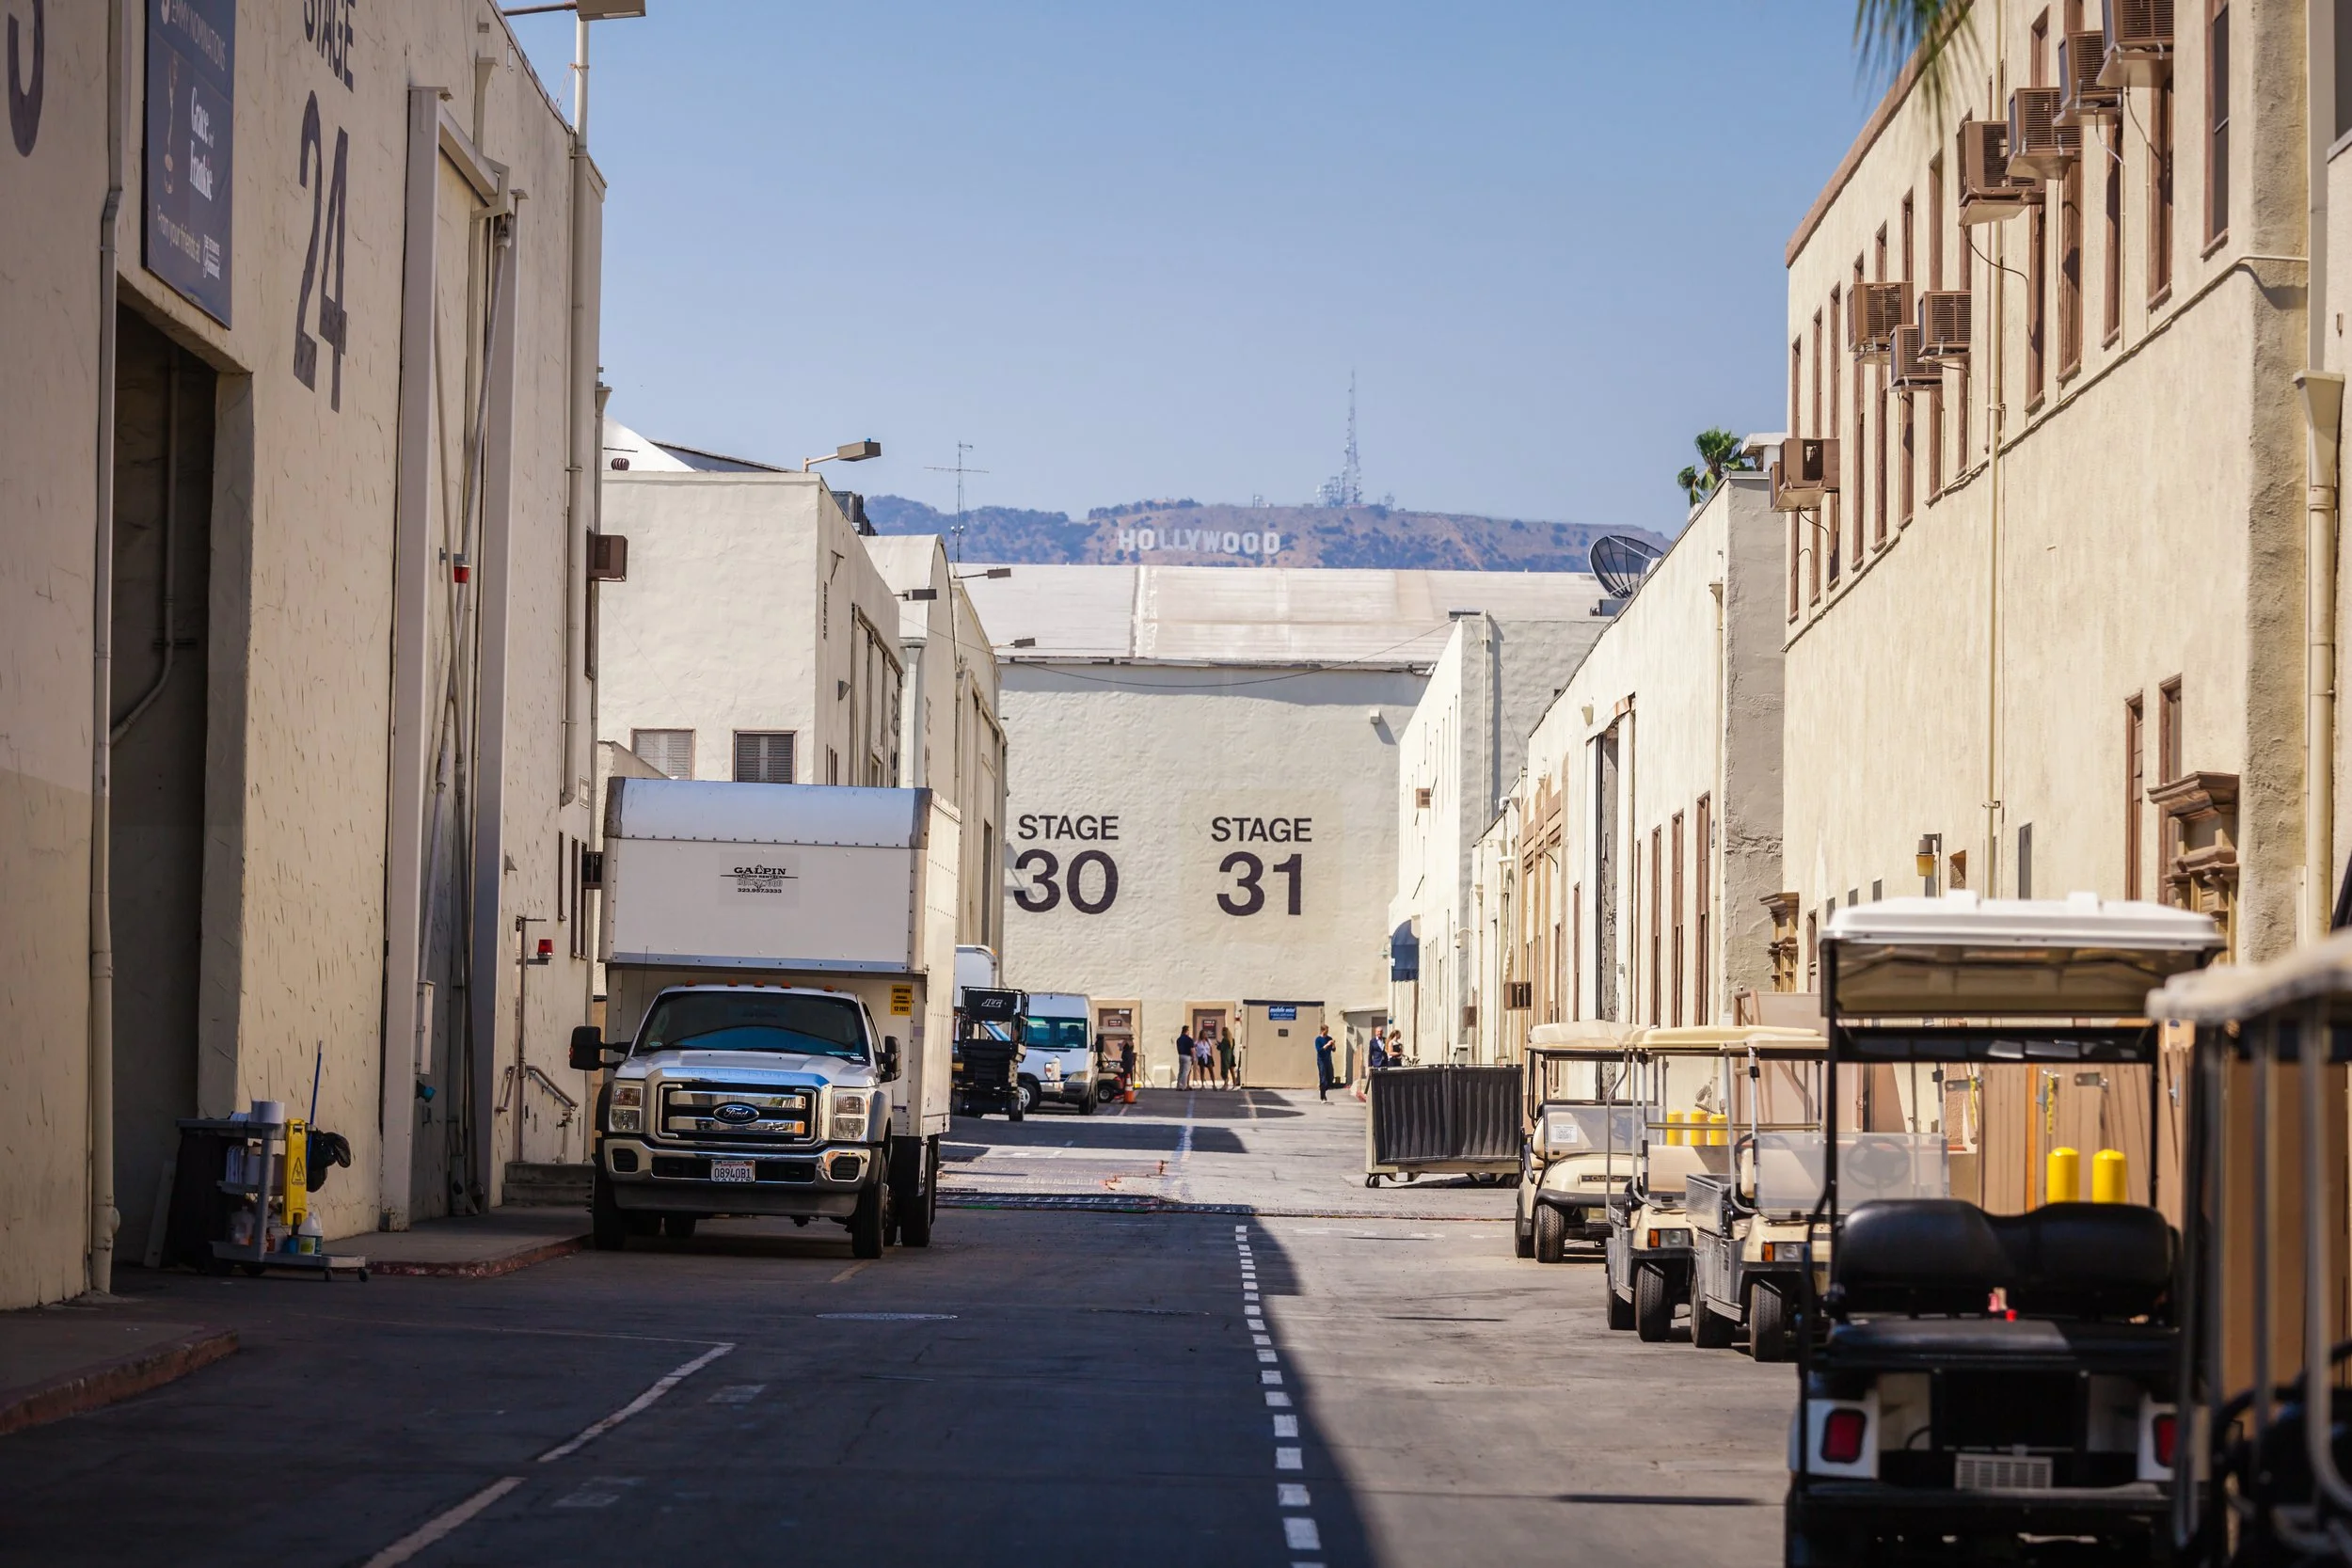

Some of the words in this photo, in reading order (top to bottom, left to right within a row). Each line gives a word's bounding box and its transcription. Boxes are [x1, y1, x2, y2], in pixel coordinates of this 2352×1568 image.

[191, 87, 209, 143] Grace
[189, 139, 213, 201] Frankie
[294, 89, 348, 414] 24
[1119, 529, 1280, 555] HOLLYWOOD
[1018, 815, 1119, 840] STAGE
[1211, 816, 1312, 842] STAGE
[734, 866, 787, 875] GALPIN
[1013, 848, 1119, 914] 30
[1216, 851, 1302, 916] 31
[981, 998, 1003, 1007] JLG
[723, 1106, 749, 1119] Ford
[715, 1167, 751, 1179] 08940B1
